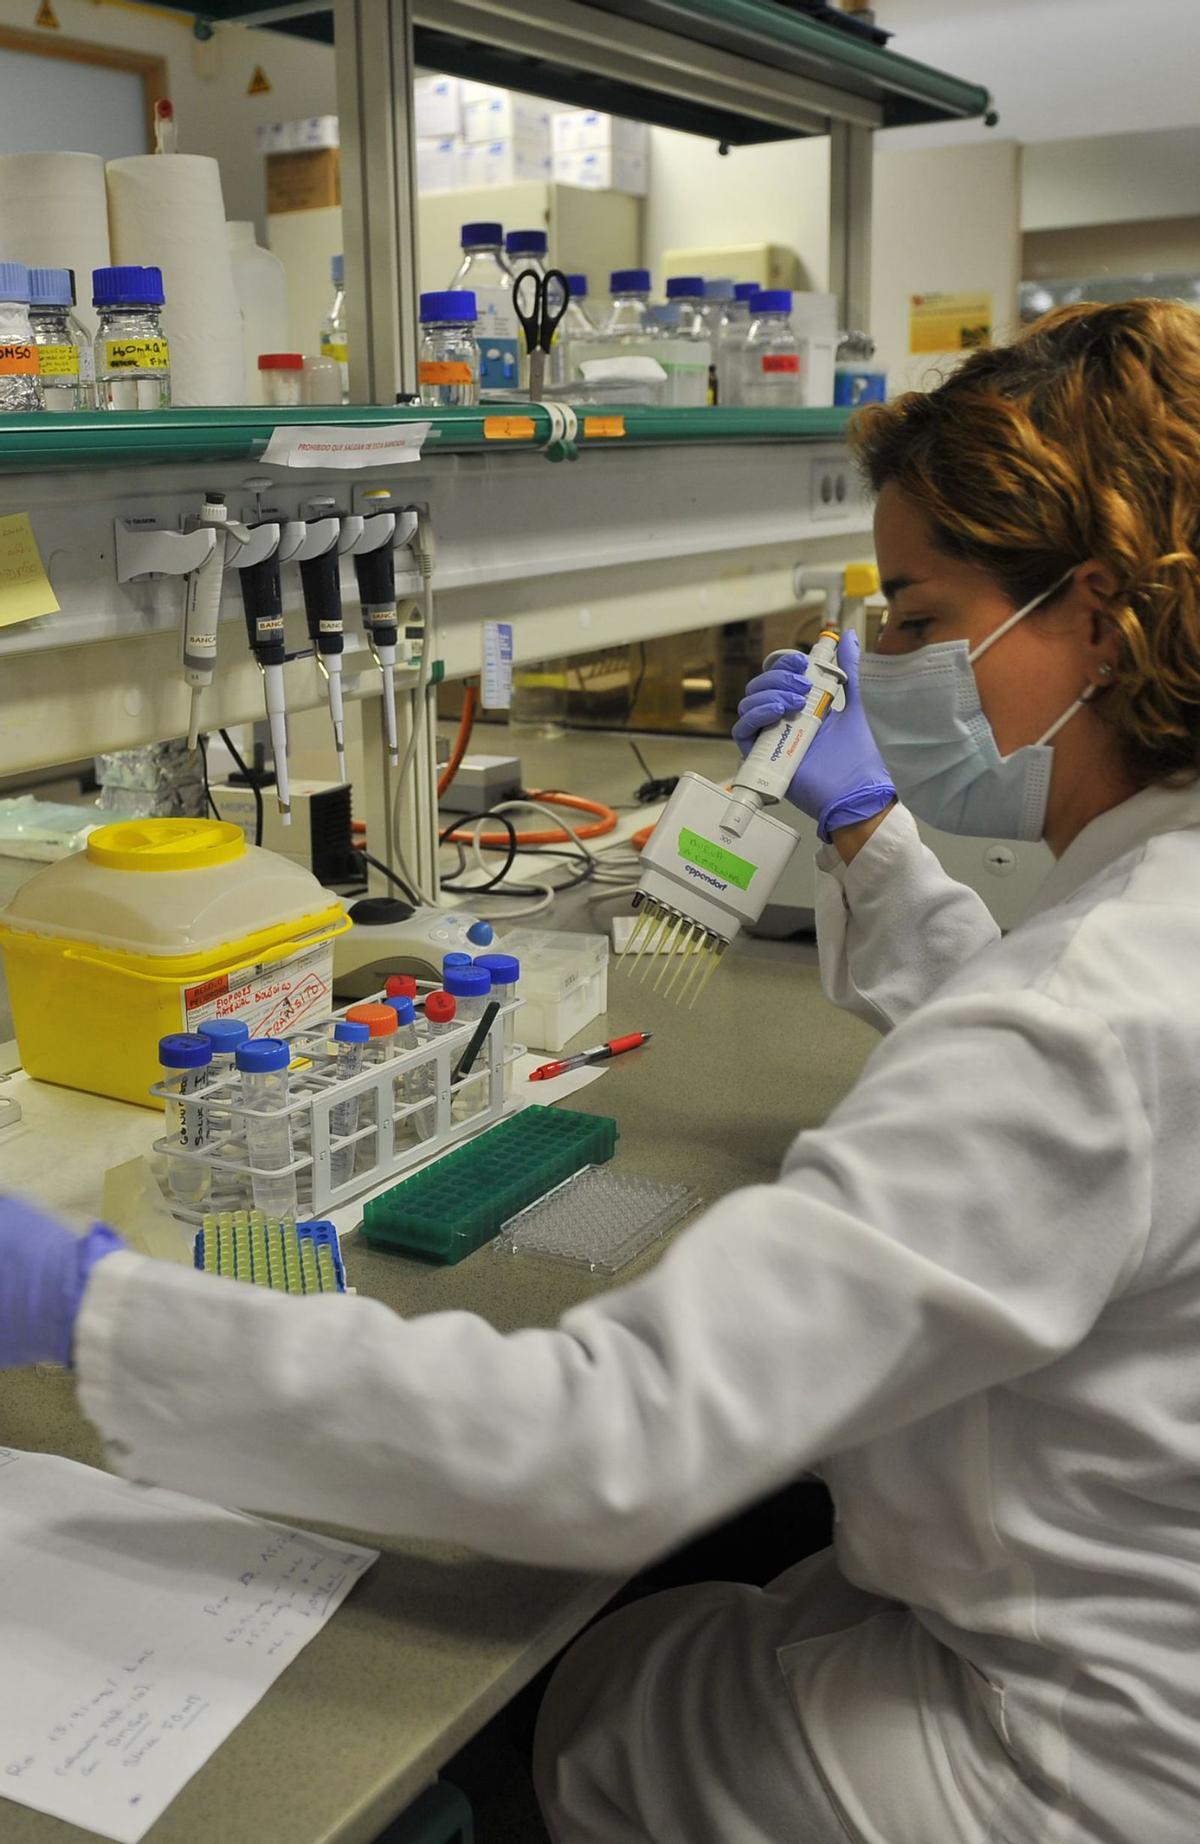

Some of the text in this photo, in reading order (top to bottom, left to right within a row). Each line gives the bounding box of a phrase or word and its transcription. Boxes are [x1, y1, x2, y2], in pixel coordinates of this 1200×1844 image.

[298, 443, 331, 452] PROHIBIDO
[770, 724, 792, 762] eppendorf
[685, 863, 729, 892] eppendorf
